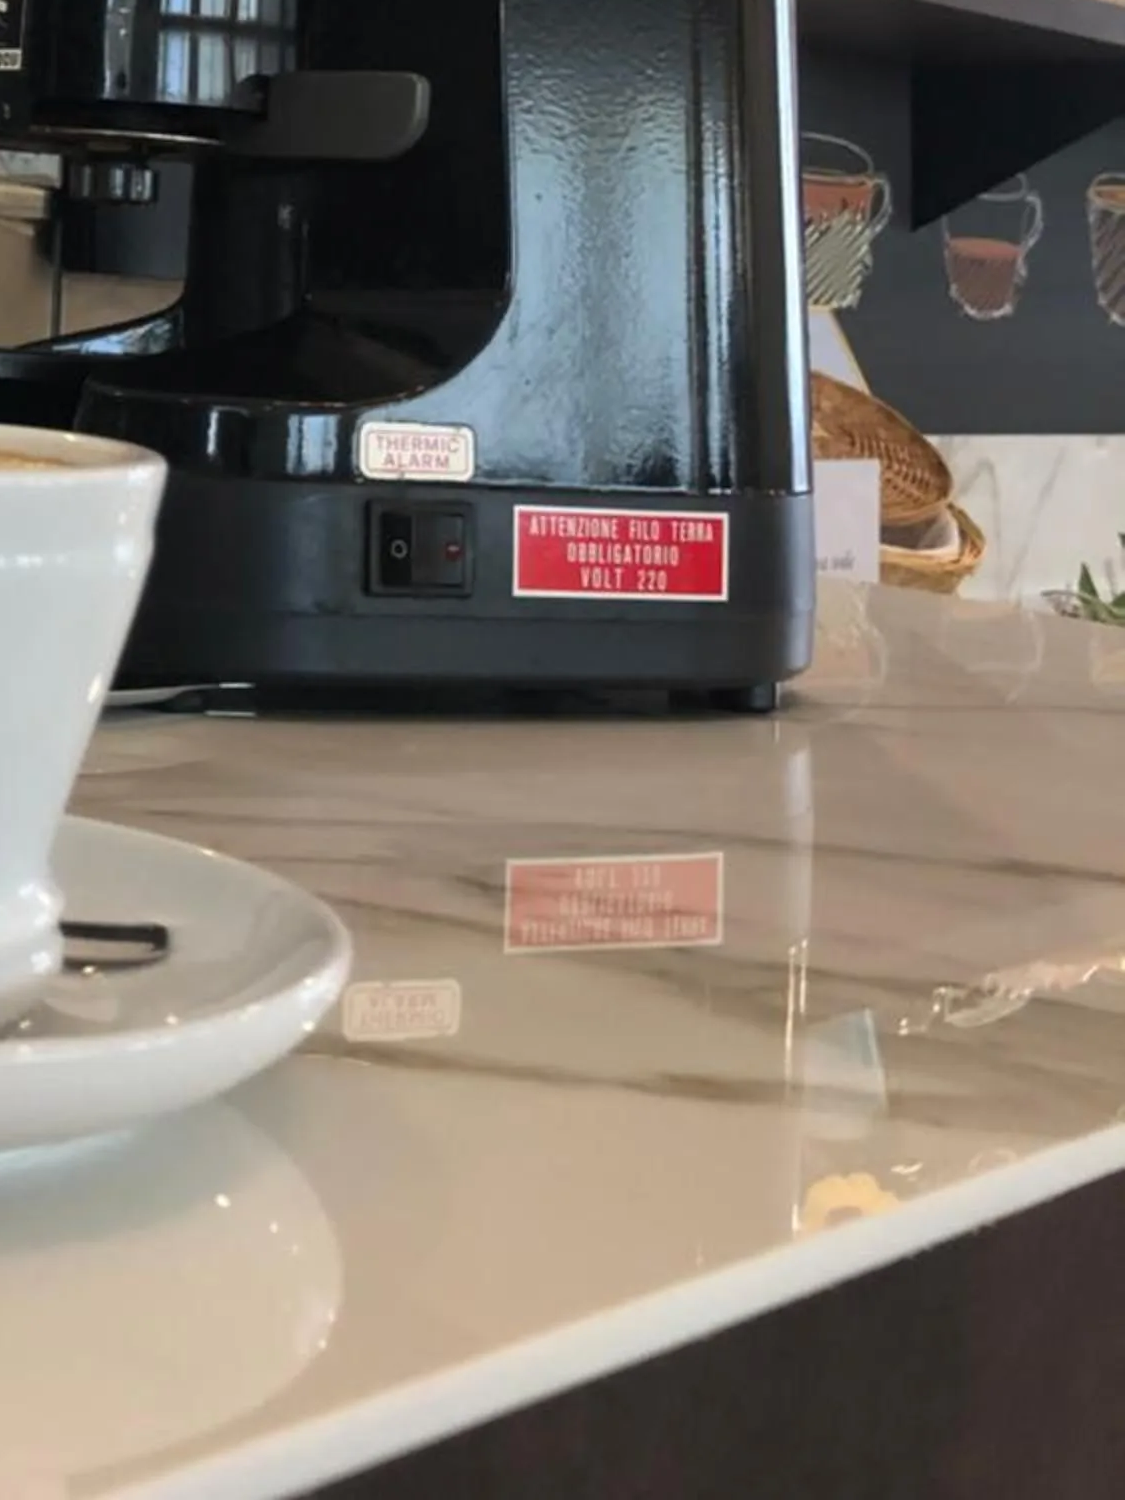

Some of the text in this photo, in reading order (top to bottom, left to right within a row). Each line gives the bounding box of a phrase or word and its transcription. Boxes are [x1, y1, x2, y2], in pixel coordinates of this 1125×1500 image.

[375, 434, 460, 453] THERMIC
[381, 451, 450, 469] ALARM
[529, 514, 714, 543] ATTENZIONE FILO TERRA
[567, 542, 680, 566] OBBLIGATORIO
[580, 566, 668, 592] VOLT 220
